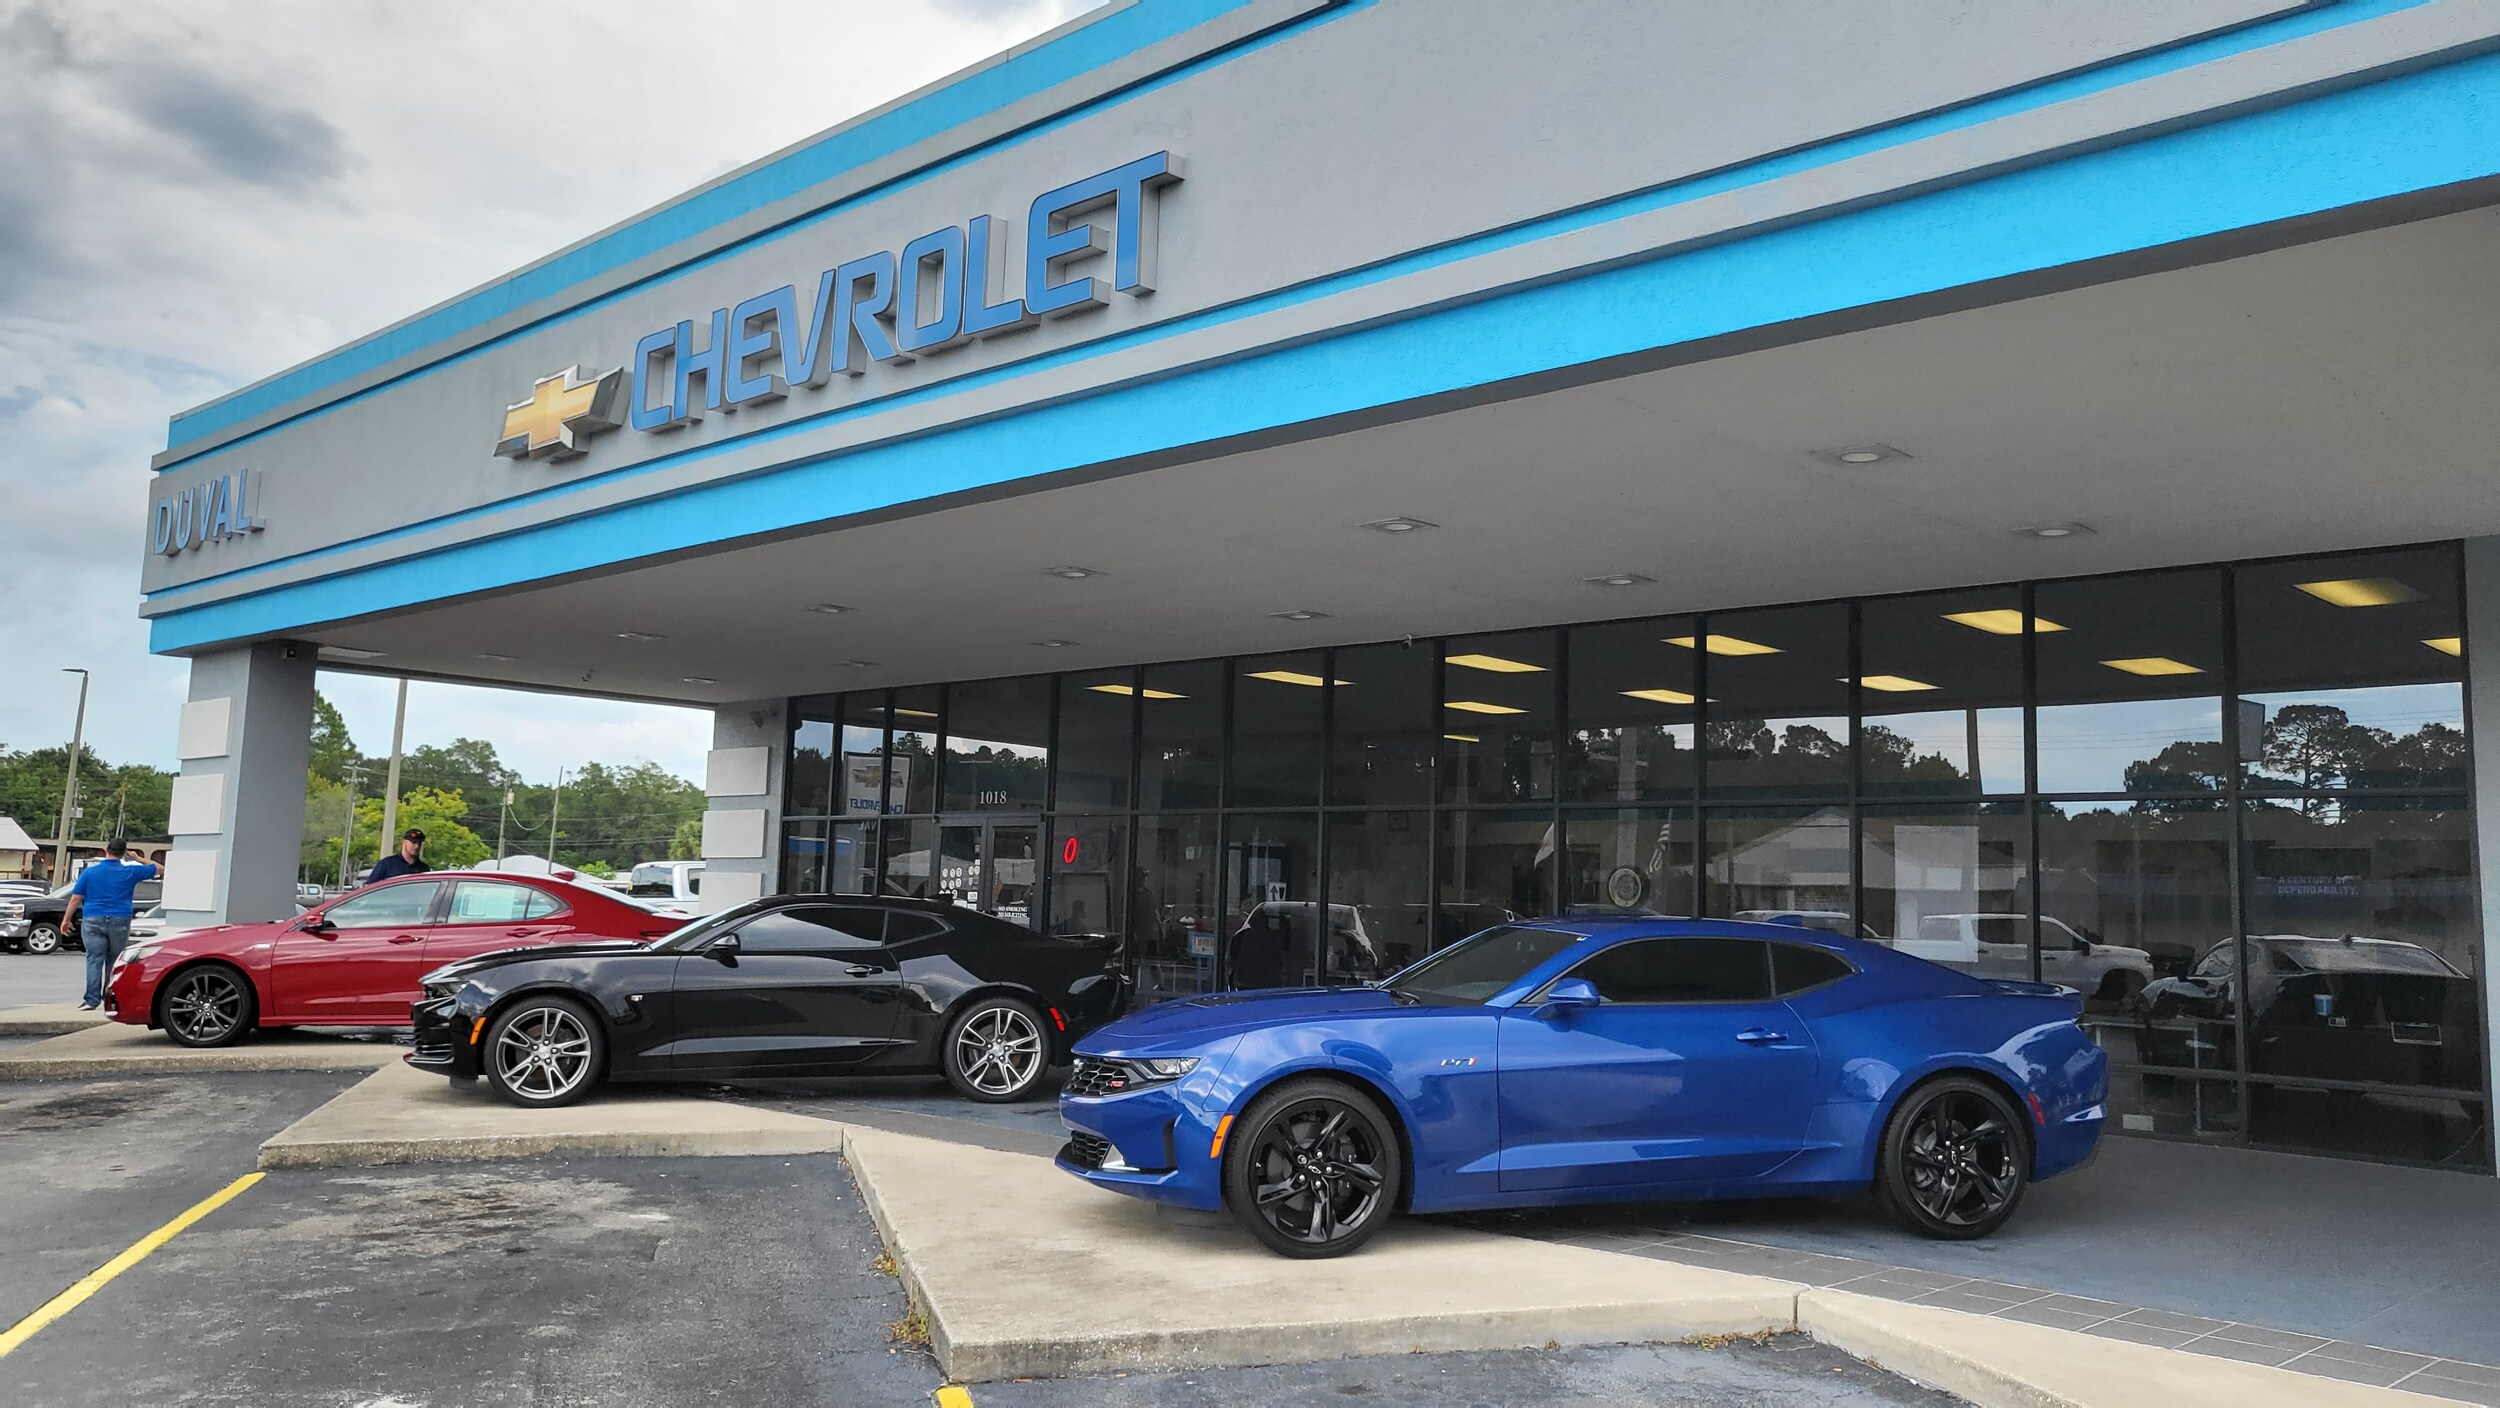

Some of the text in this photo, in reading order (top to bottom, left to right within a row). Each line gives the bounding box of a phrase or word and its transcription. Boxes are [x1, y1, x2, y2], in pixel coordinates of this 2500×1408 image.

[631, 150, 1173, 433] CHEVROLET
[153, 468, 256, 556] DUVAL
[979, 790, 1007, 805] 1018
